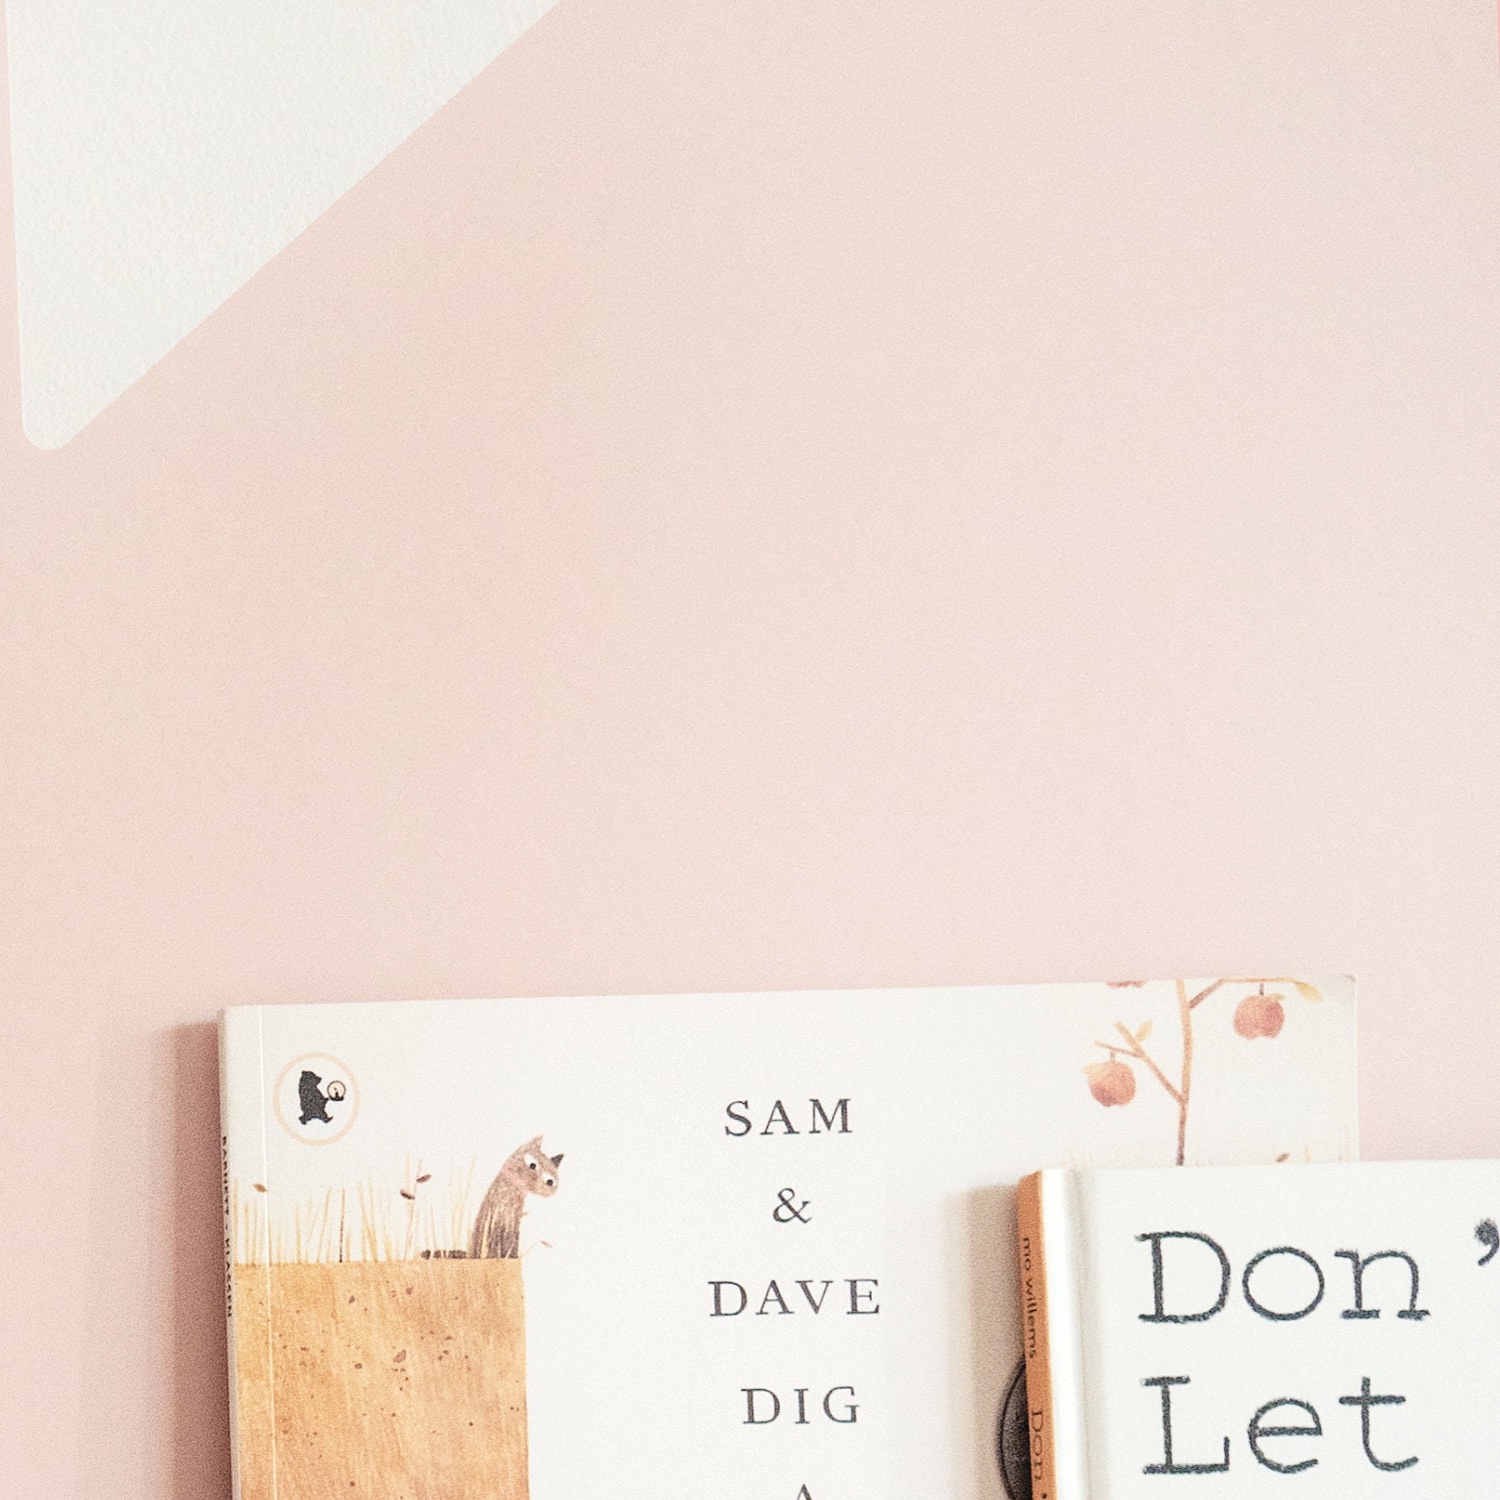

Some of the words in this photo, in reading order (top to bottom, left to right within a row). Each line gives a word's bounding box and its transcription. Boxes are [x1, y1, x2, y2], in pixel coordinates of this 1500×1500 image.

[724, 1098, 853, 1137] SAM
[772, 1187, 812, 1224] &
[1023, 1237, 1033, 1272] mo
[707, 1278, 881, 1317] DAVE
[1026, 1278, 1038, 1359] willems
[741, 1385, 859, 1425] DIG
[1142, 1376, 1419, 1475] Let
